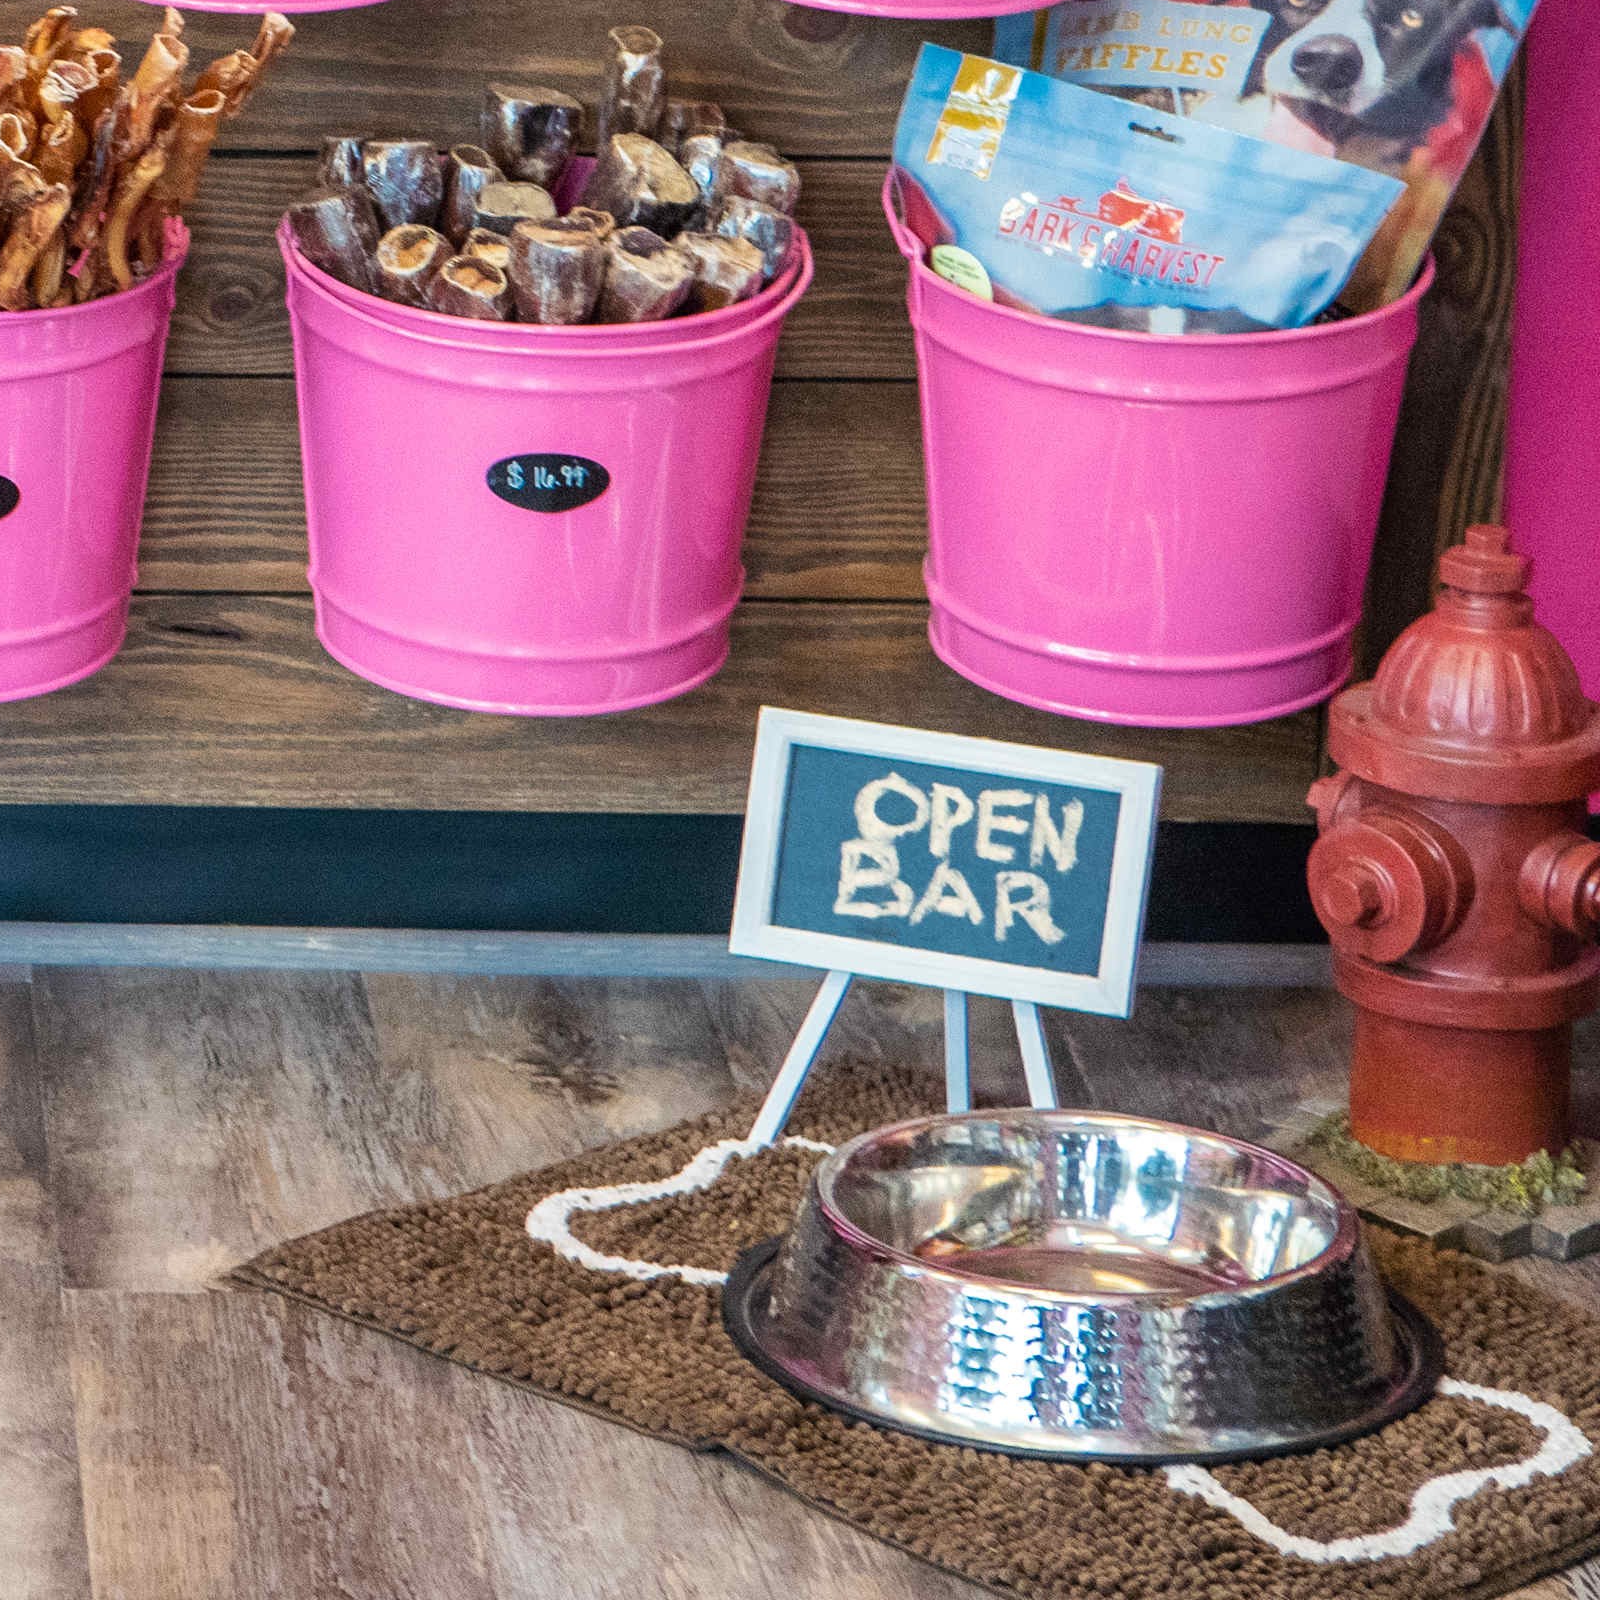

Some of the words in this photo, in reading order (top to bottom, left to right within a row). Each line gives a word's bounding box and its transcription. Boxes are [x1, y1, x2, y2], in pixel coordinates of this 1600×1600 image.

[1060, 11, 1141, 37] AMB
[1158, 16, 1253, 44] LUNG
[1000, 200, 1075, 251] BARK
[1101, 234, 1225, 288] HARVEST
[855, 772, 1084, 873] OPEN
[834, 838, 1065, 945] BAR
